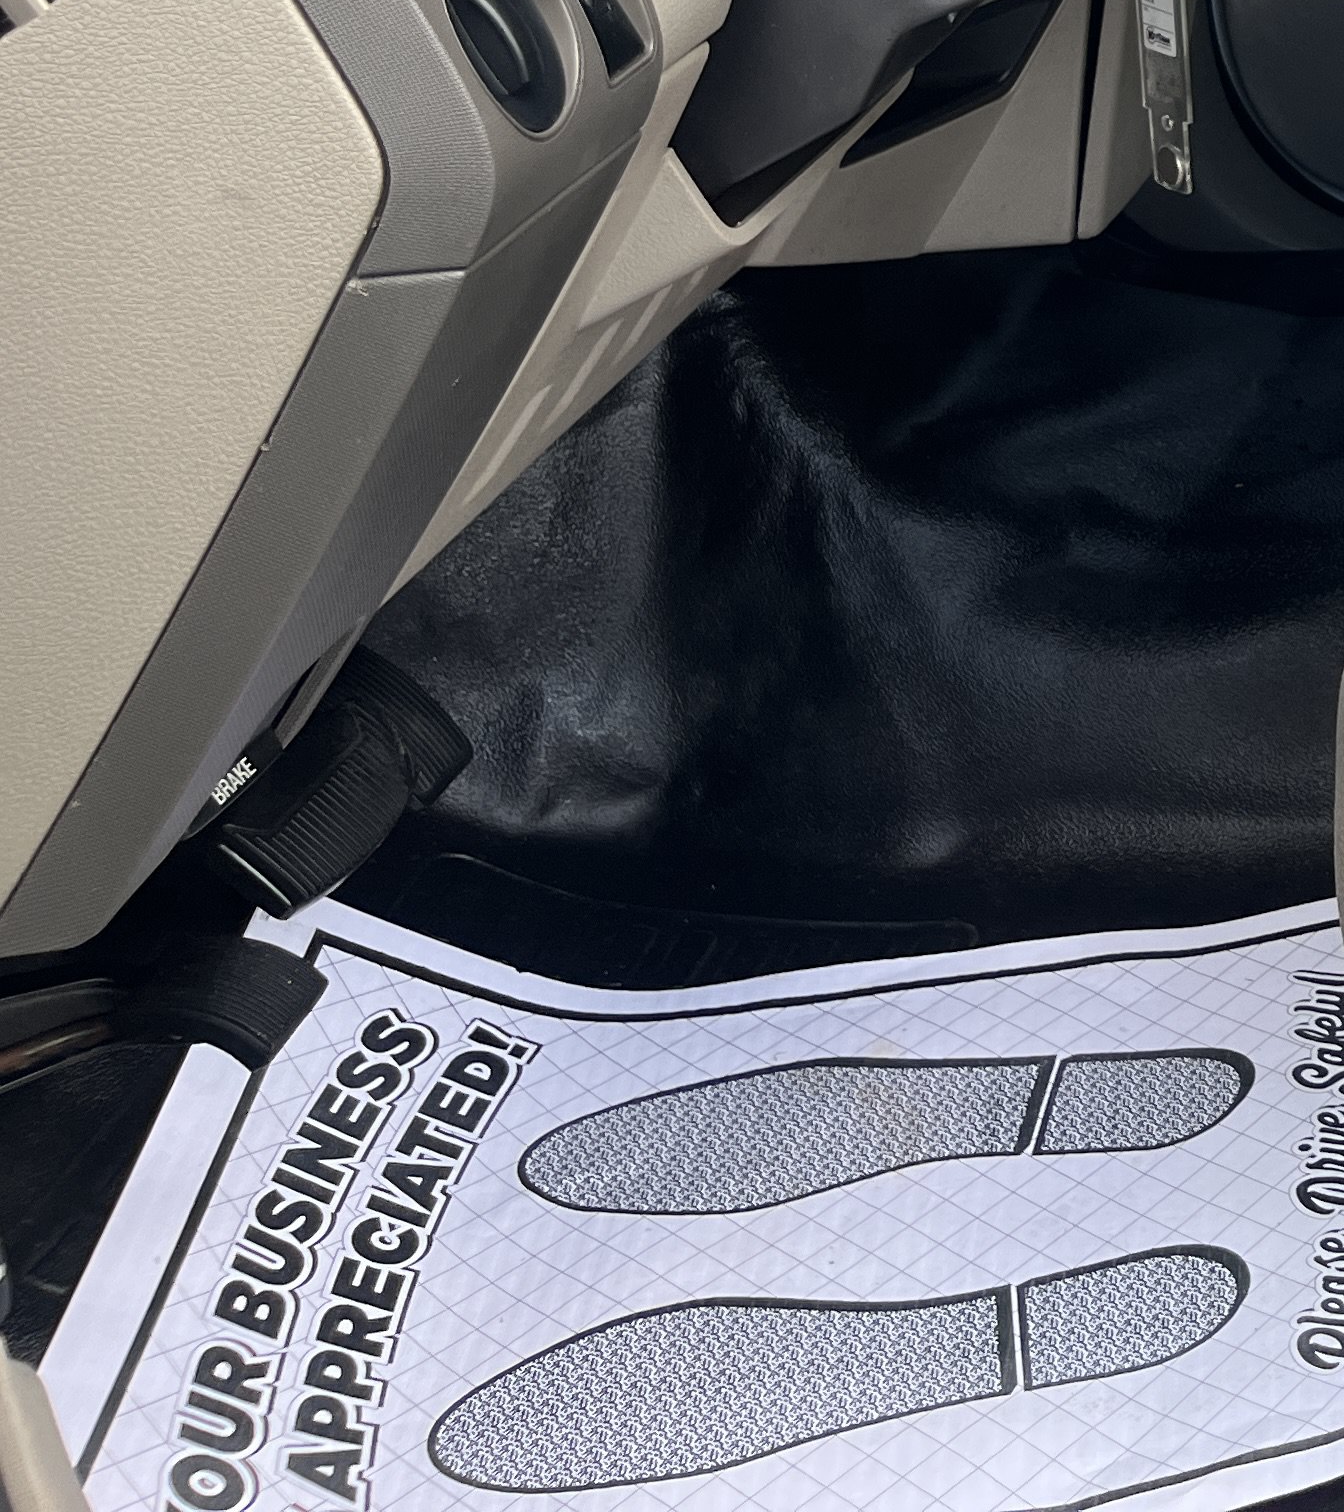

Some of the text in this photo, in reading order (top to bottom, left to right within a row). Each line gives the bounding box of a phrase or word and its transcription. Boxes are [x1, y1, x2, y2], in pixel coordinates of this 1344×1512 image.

[210, 756, 257, 805] BRAKE
[163, 1009, 428, 1512] OUR BUSINESS
[285, 1023, 532, 1504] APPRECIATED!
